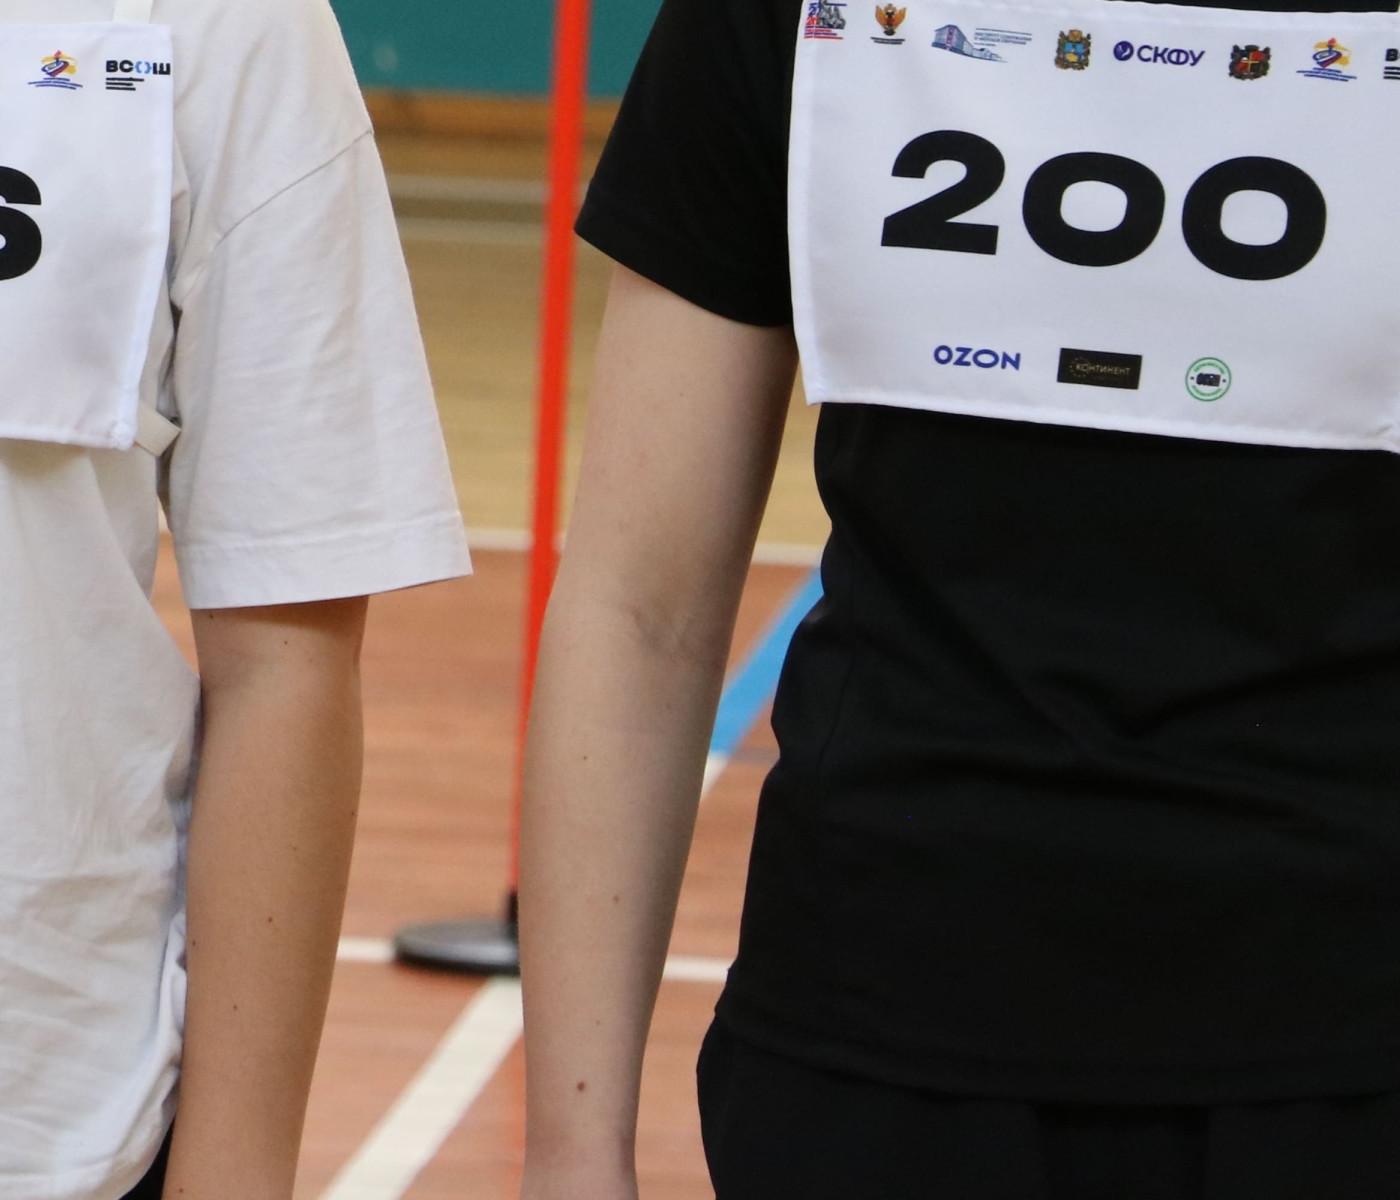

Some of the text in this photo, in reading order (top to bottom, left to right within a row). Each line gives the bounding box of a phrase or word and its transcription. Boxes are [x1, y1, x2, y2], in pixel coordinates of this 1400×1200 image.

[1137, 44, 1205, 67] СКФУ
[881, 130, 1327, 281] 200
[933, 345, 1021, 371] OZON
[1076, 363, 1131, 376] КОНТИНЕНТ
